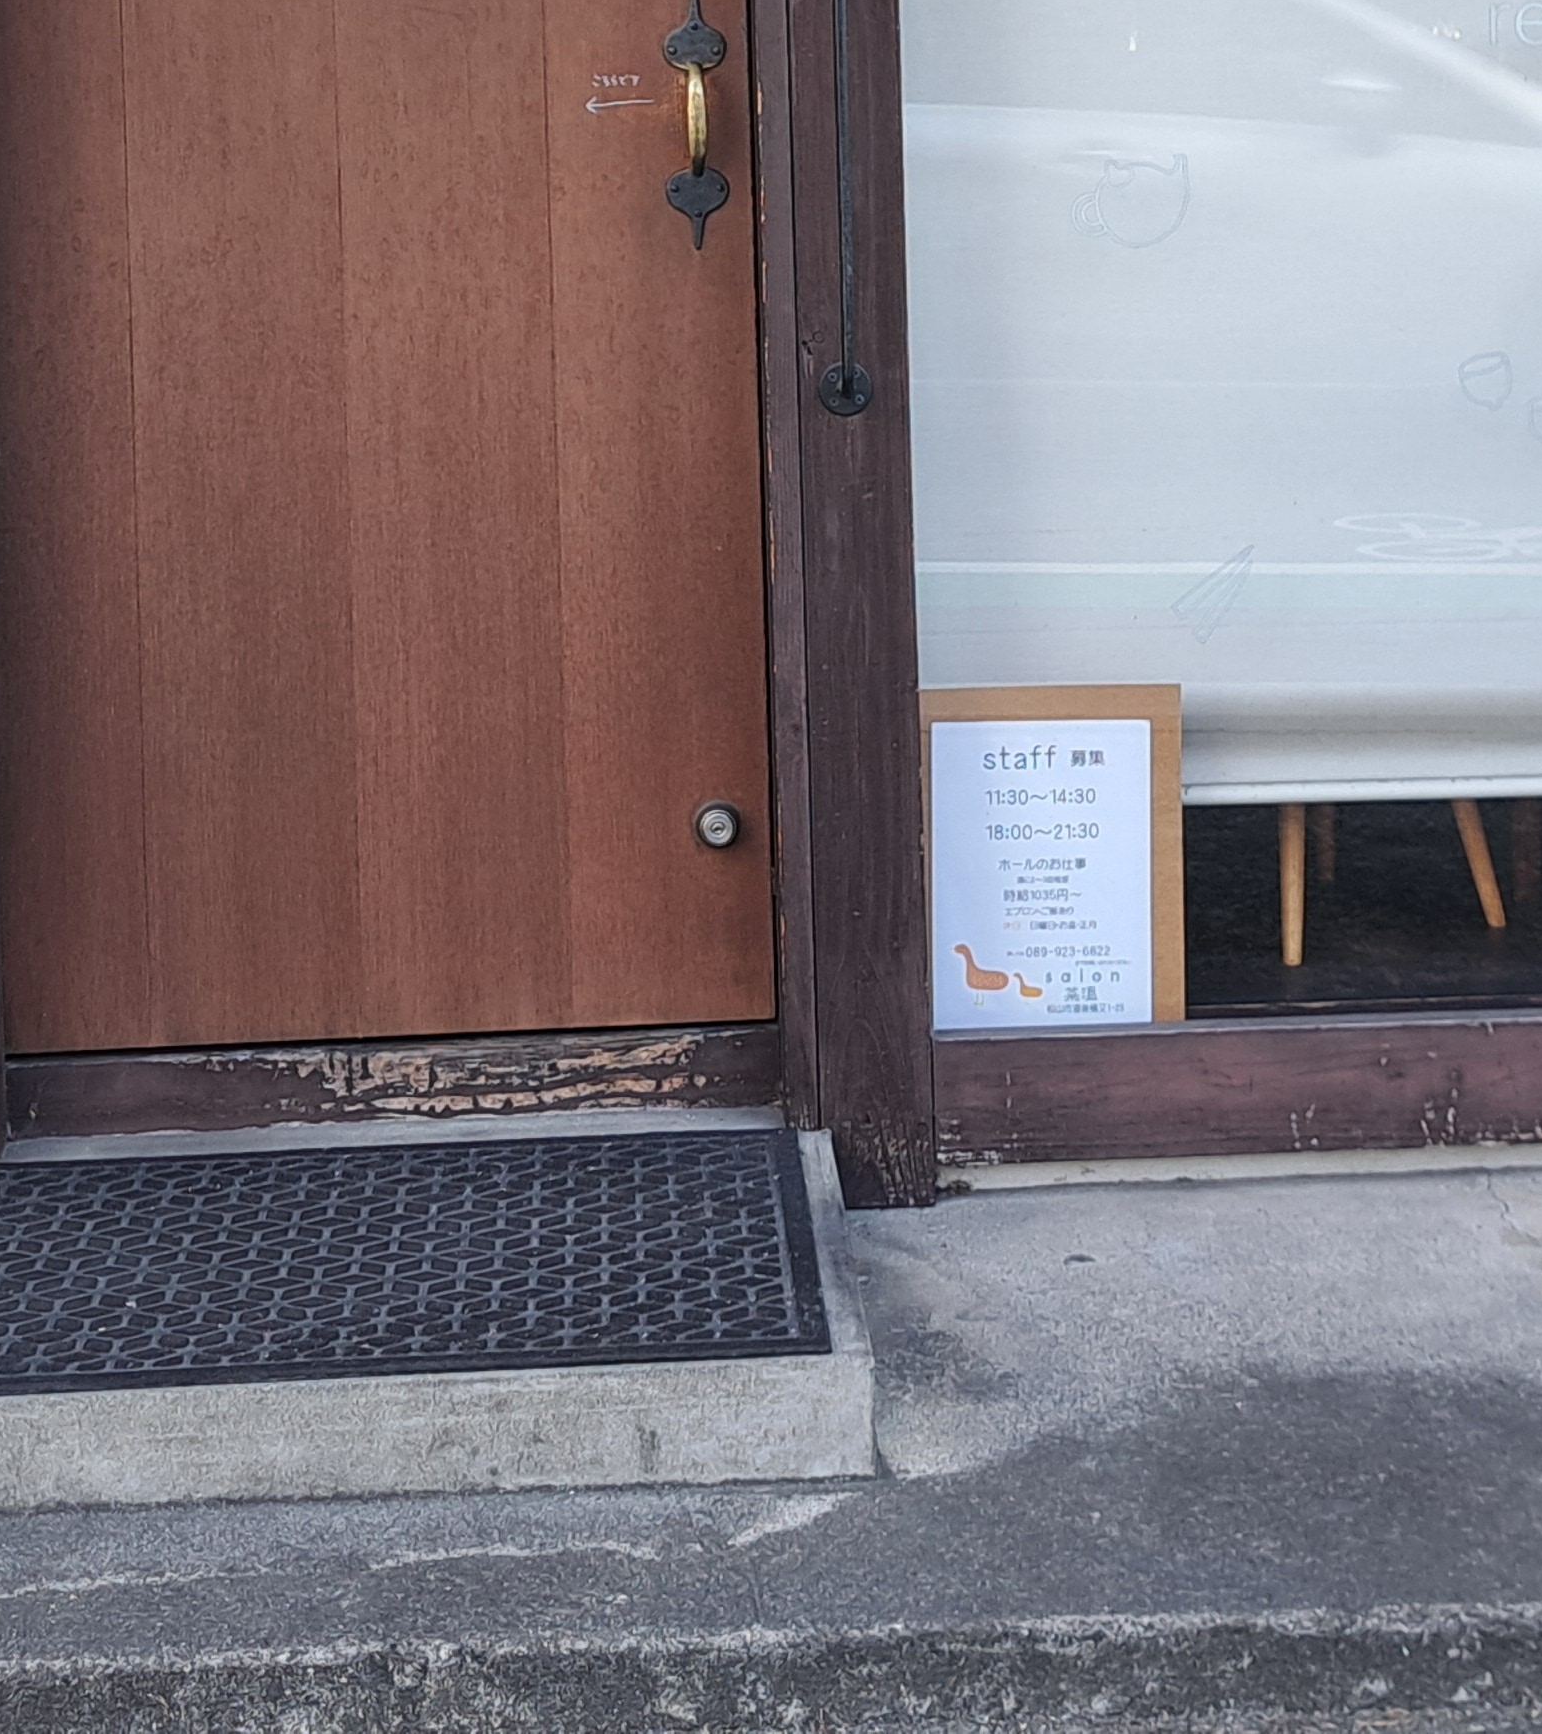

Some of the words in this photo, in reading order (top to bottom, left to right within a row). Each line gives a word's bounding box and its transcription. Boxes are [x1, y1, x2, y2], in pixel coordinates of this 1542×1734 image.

[982, 745, 1057, 770] staff
[1070, 750, 1105, 767] 募集
[998, 858, 1087, 872] ホールのお仕事
